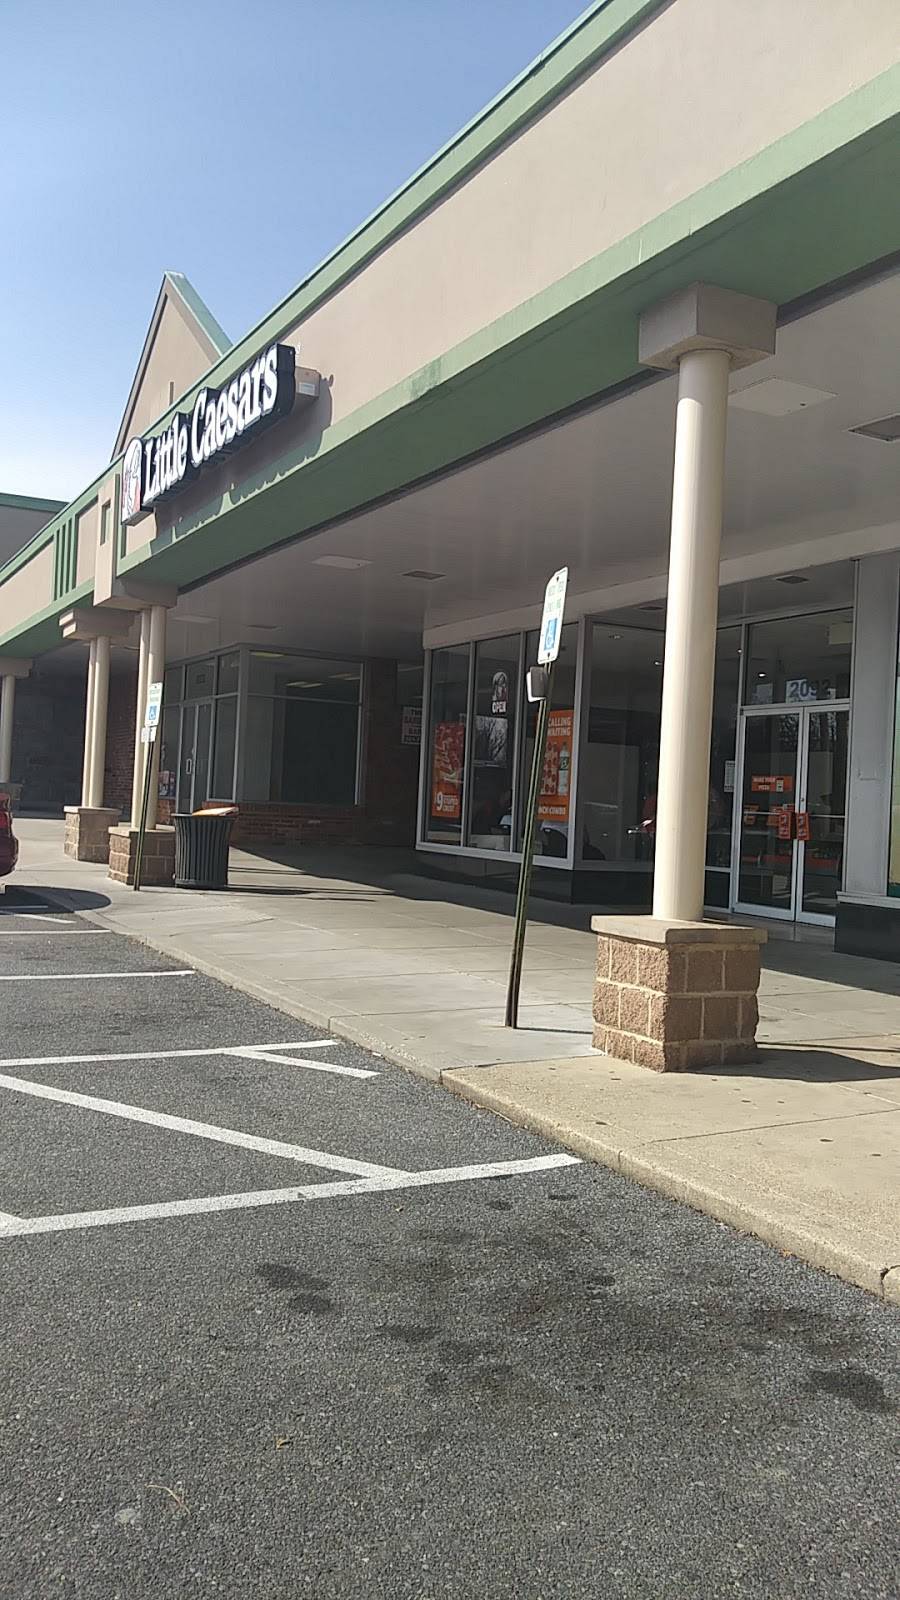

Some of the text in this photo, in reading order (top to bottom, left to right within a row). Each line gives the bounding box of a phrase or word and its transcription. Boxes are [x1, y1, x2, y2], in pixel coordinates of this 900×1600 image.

[142, 345, 278, 503] Little Caesars
[492, 701, 507, 713] OPEN
[547, 717, 572, 727] CALLING
